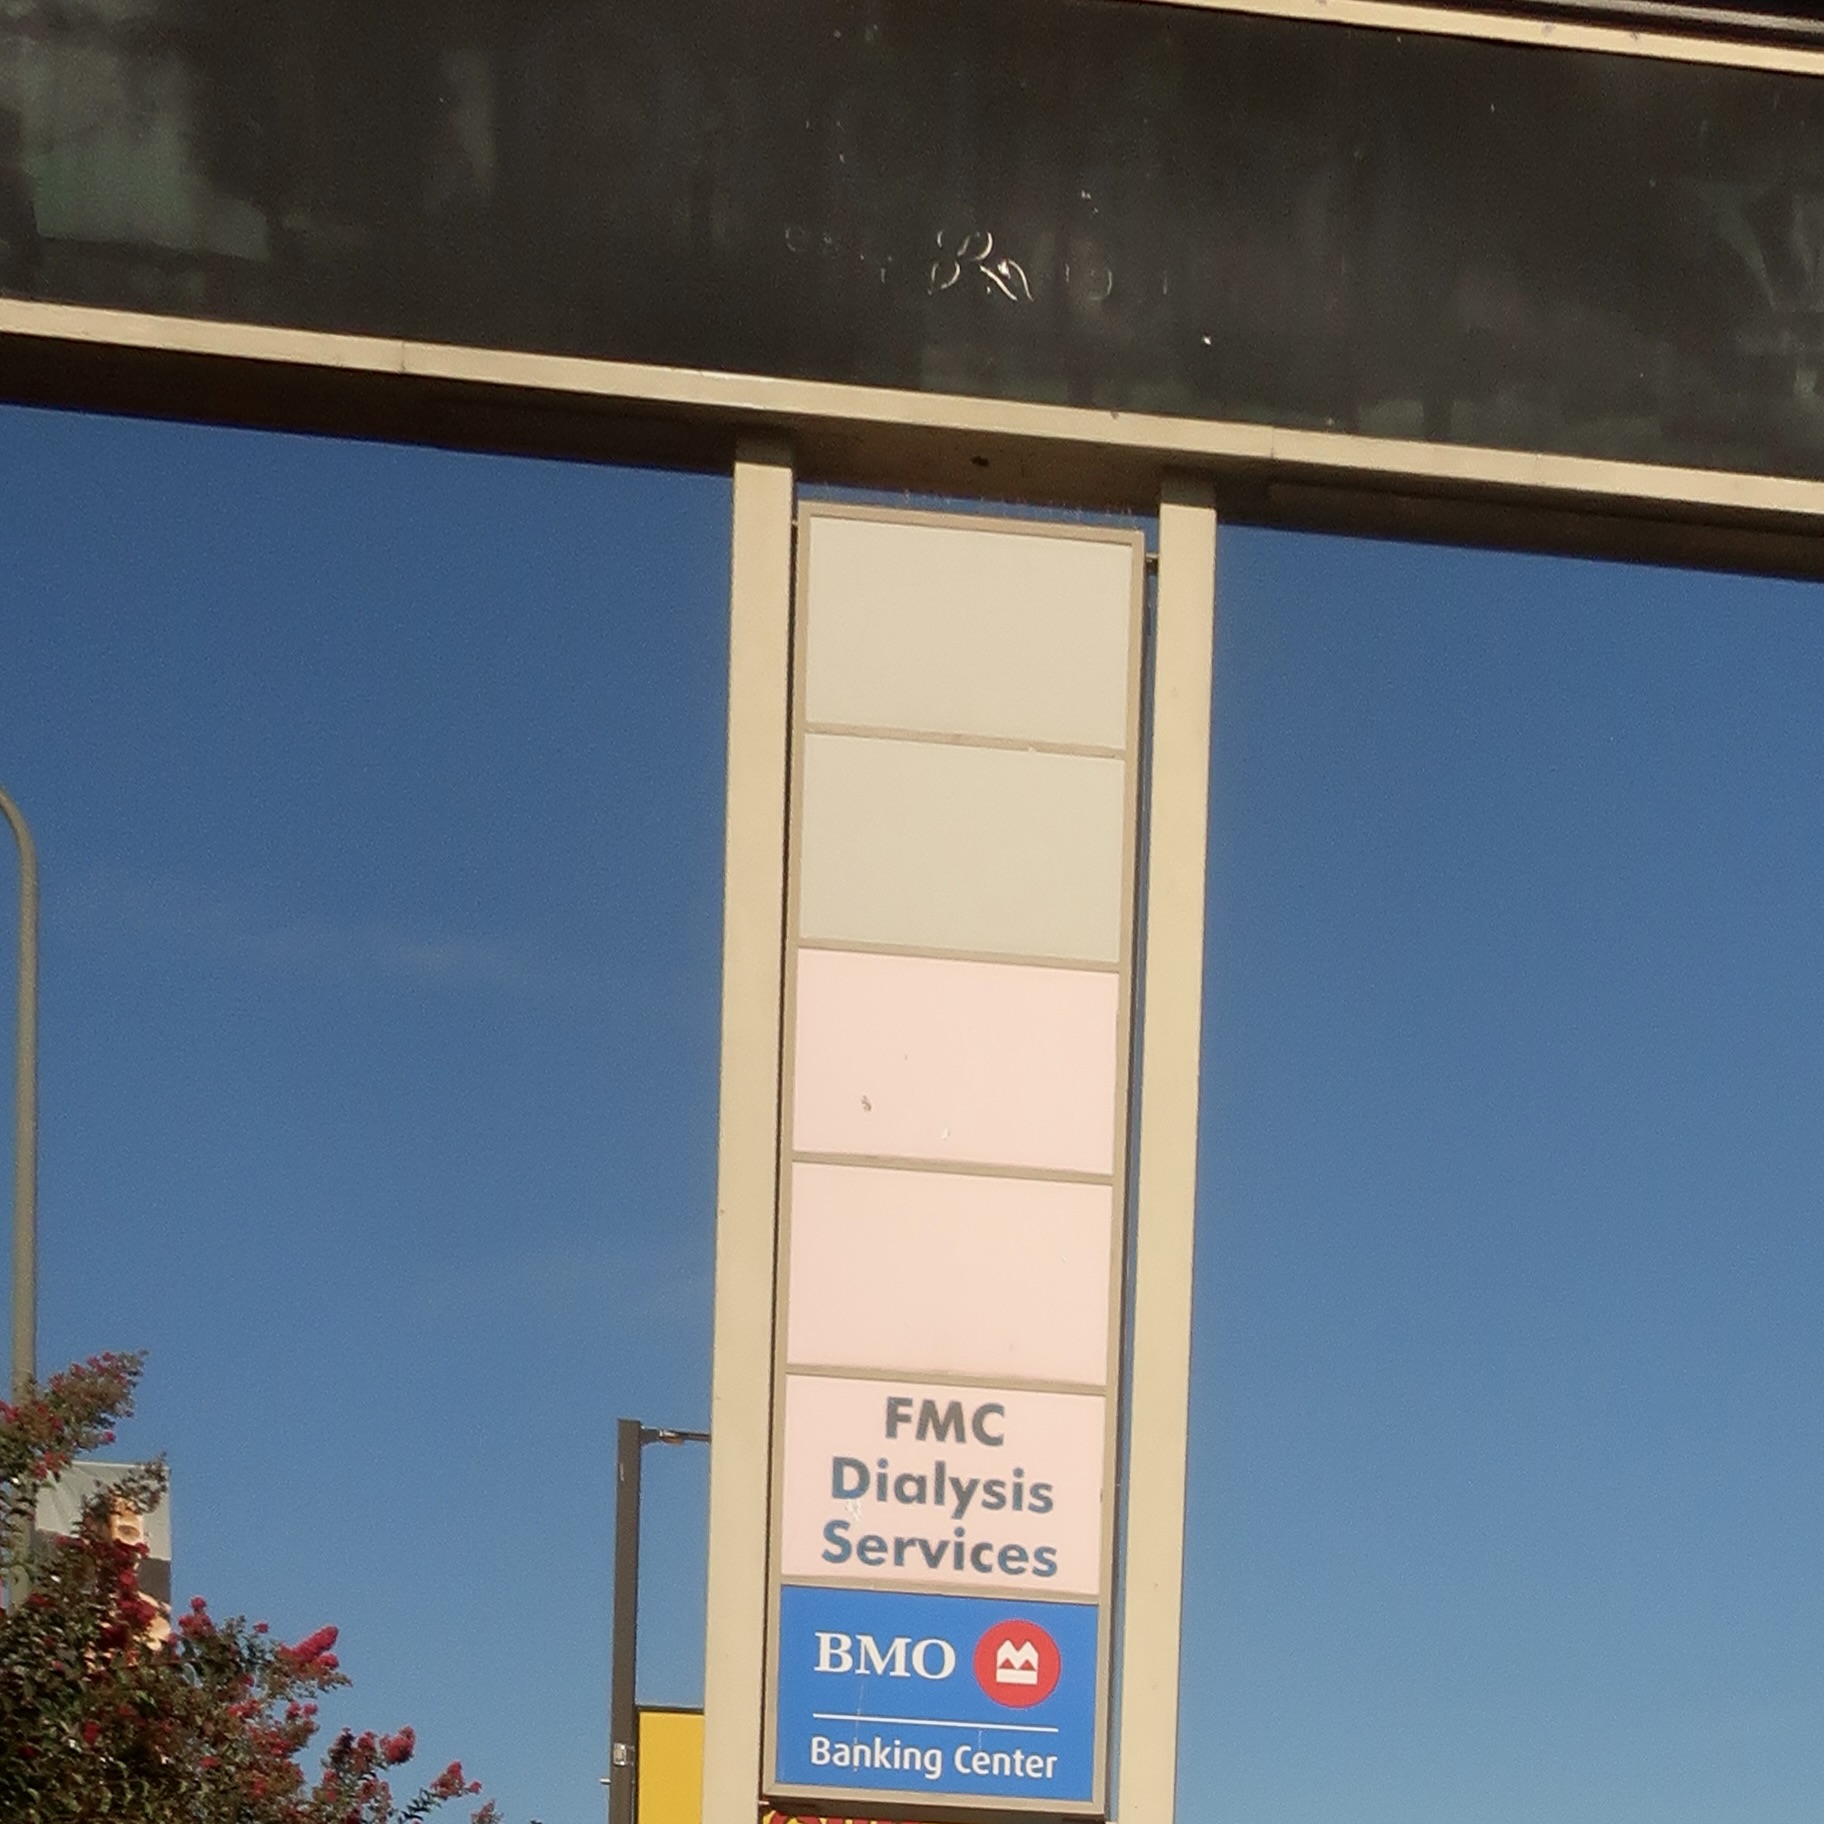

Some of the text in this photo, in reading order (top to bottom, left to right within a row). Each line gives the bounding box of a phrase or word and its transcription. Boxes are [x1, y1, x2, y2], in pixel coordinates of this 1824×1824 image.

[885, 1396, 1006, 1447] FMC
[830, 1456, 1055, 1520] Dialysis
[821, 1519, 1059, 1578] Services
[813, 1631, 957, 1681] BMO
[810, 1735, 1058, 1780] Banking Center
